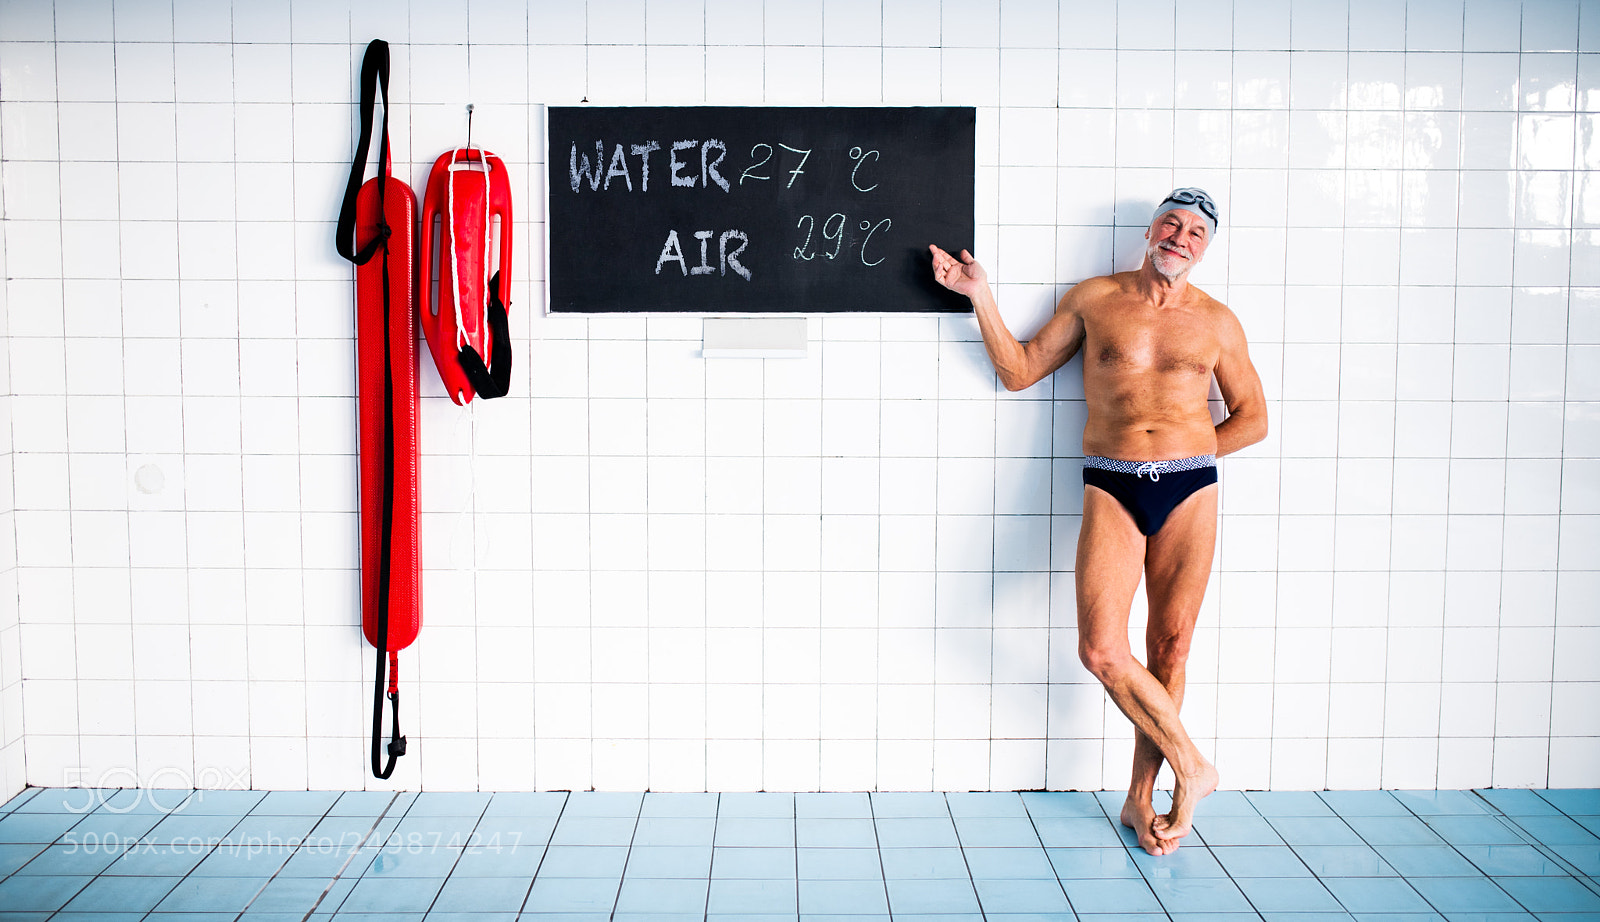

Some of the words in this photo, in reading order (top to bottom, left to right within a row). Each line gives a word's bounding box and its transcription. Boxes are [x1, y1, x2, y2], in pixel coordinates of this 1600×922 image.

[569, 139, 730, 192] WATER
[739, 143, 812, 188] 27
[655, 230, 752, 281] AIR
